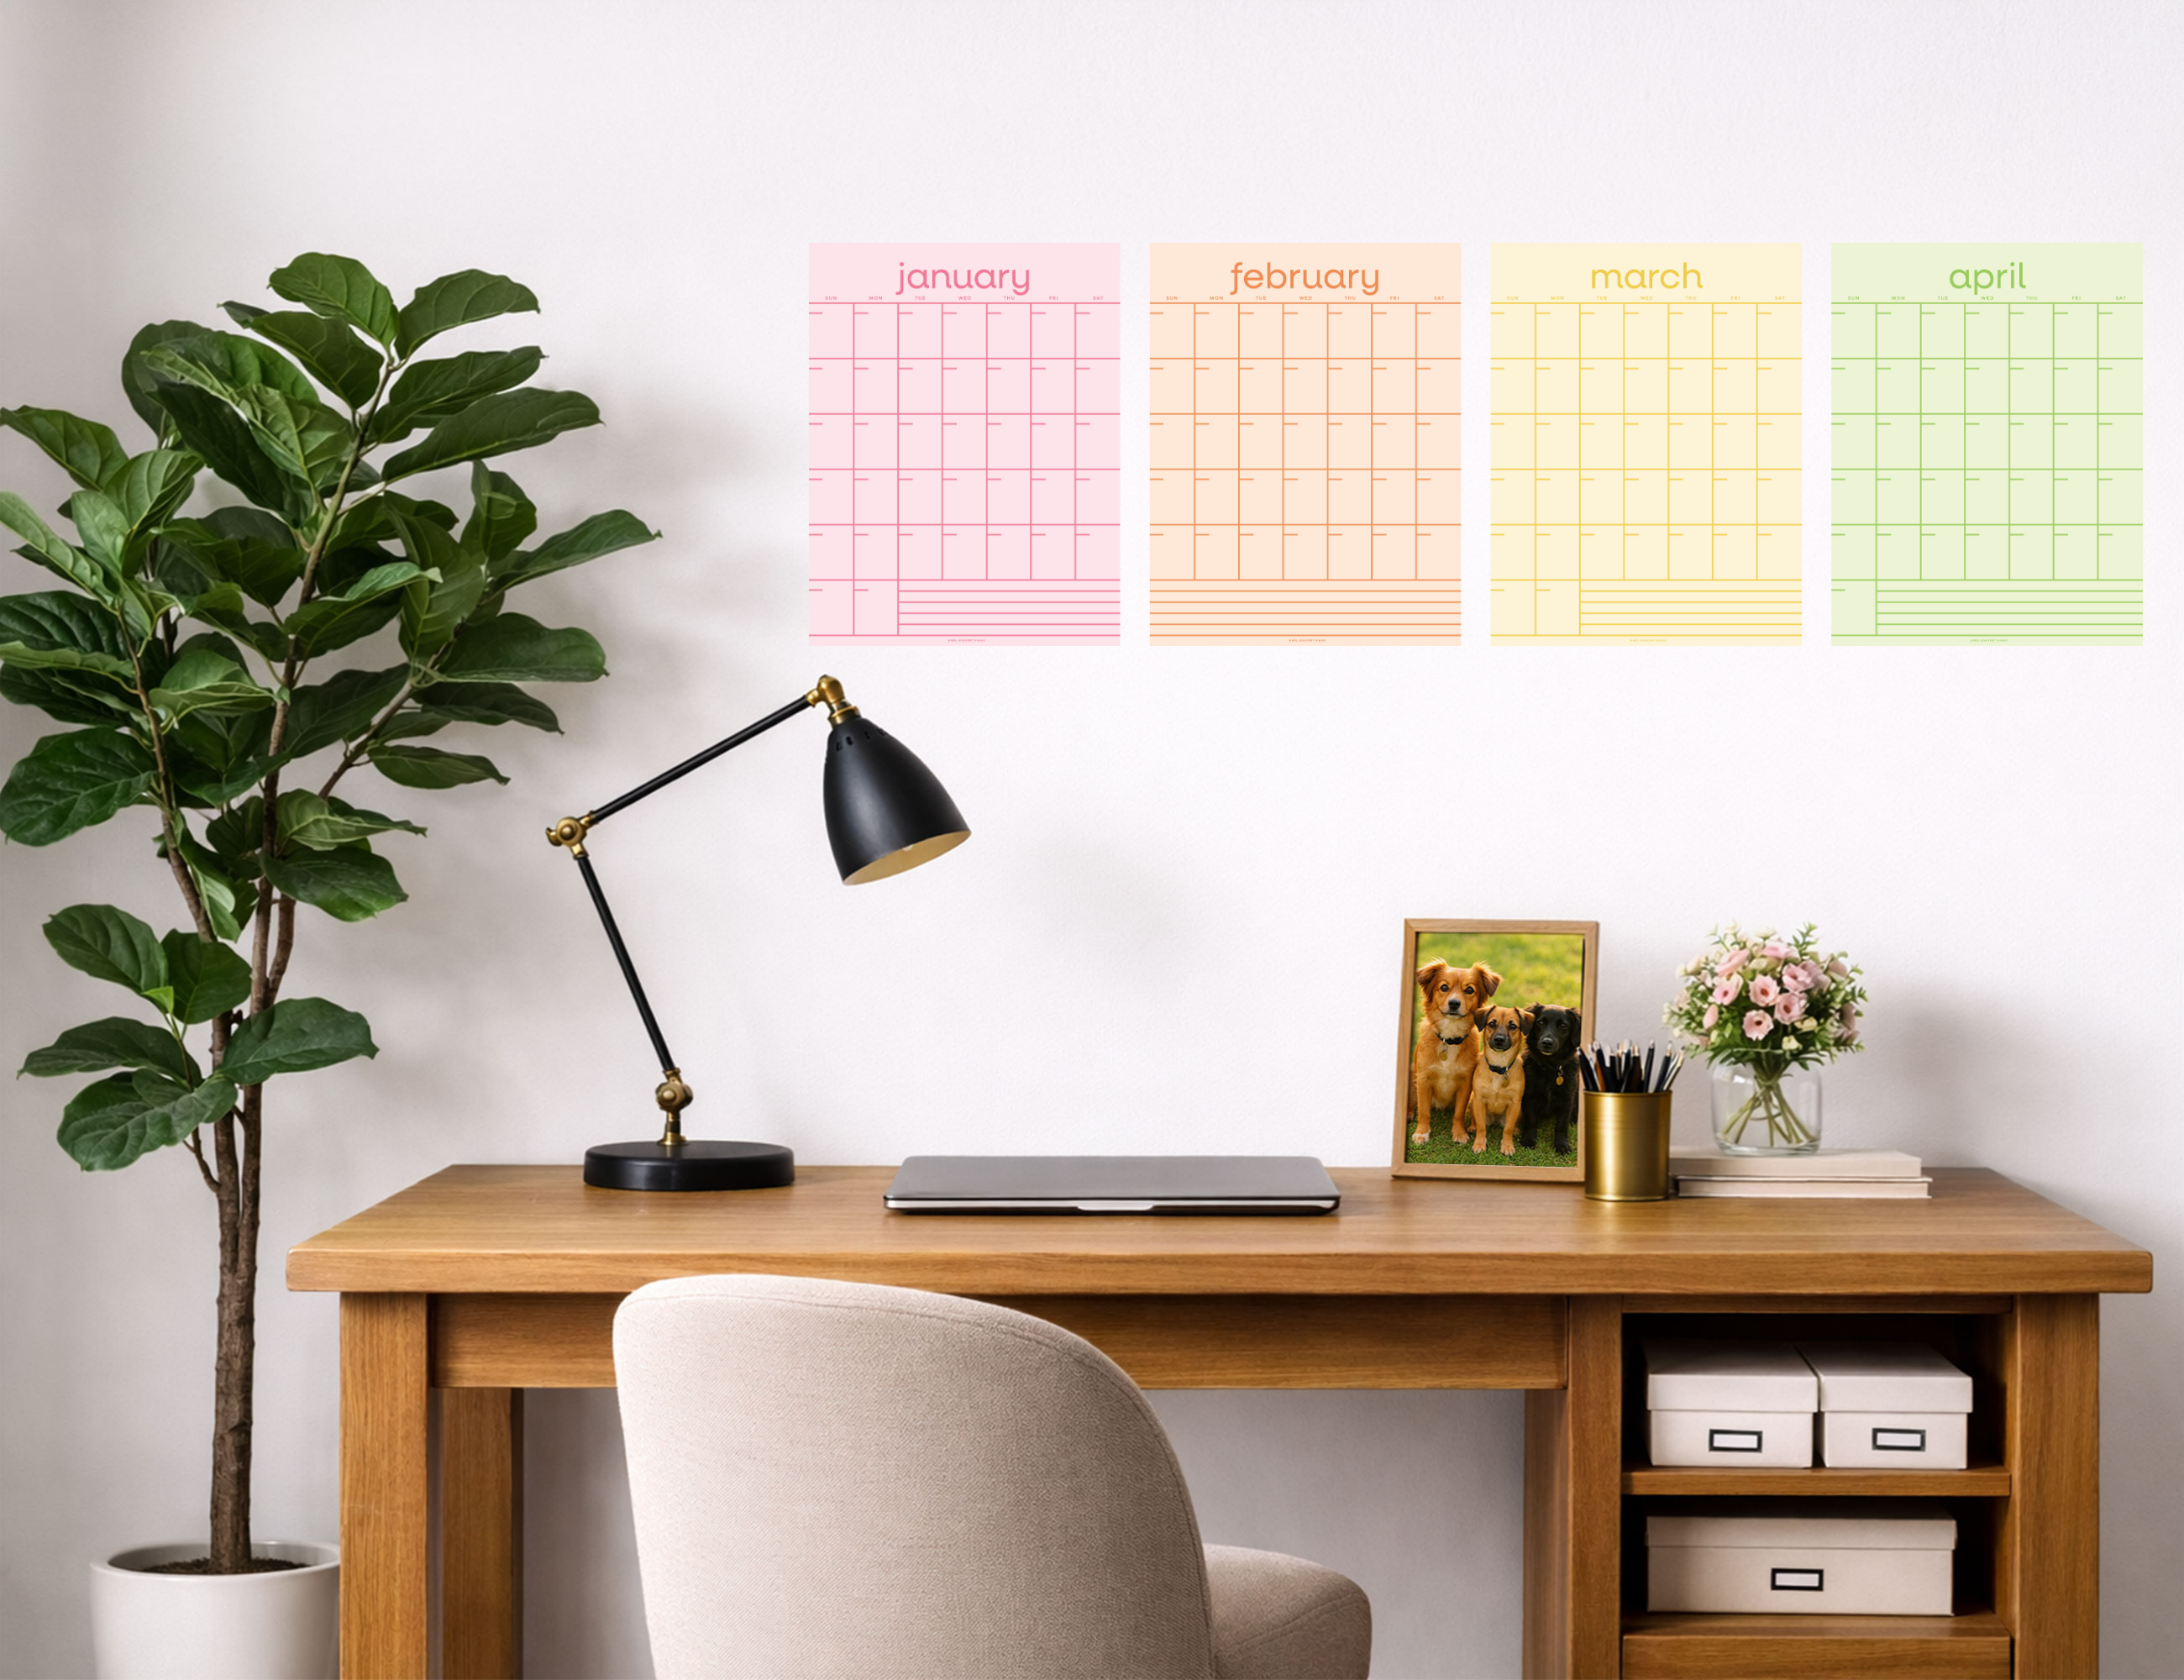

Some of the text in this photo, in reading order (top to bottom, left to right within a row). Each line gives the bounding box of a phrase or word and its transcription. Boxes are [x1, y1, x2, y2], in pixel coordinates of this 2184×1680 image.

[895, 262, 1029, 296] january
[1230, 262, 1378, 296] february
[1592, 262, 1703, 289] march
[1950, 262, 2026, 295] april
